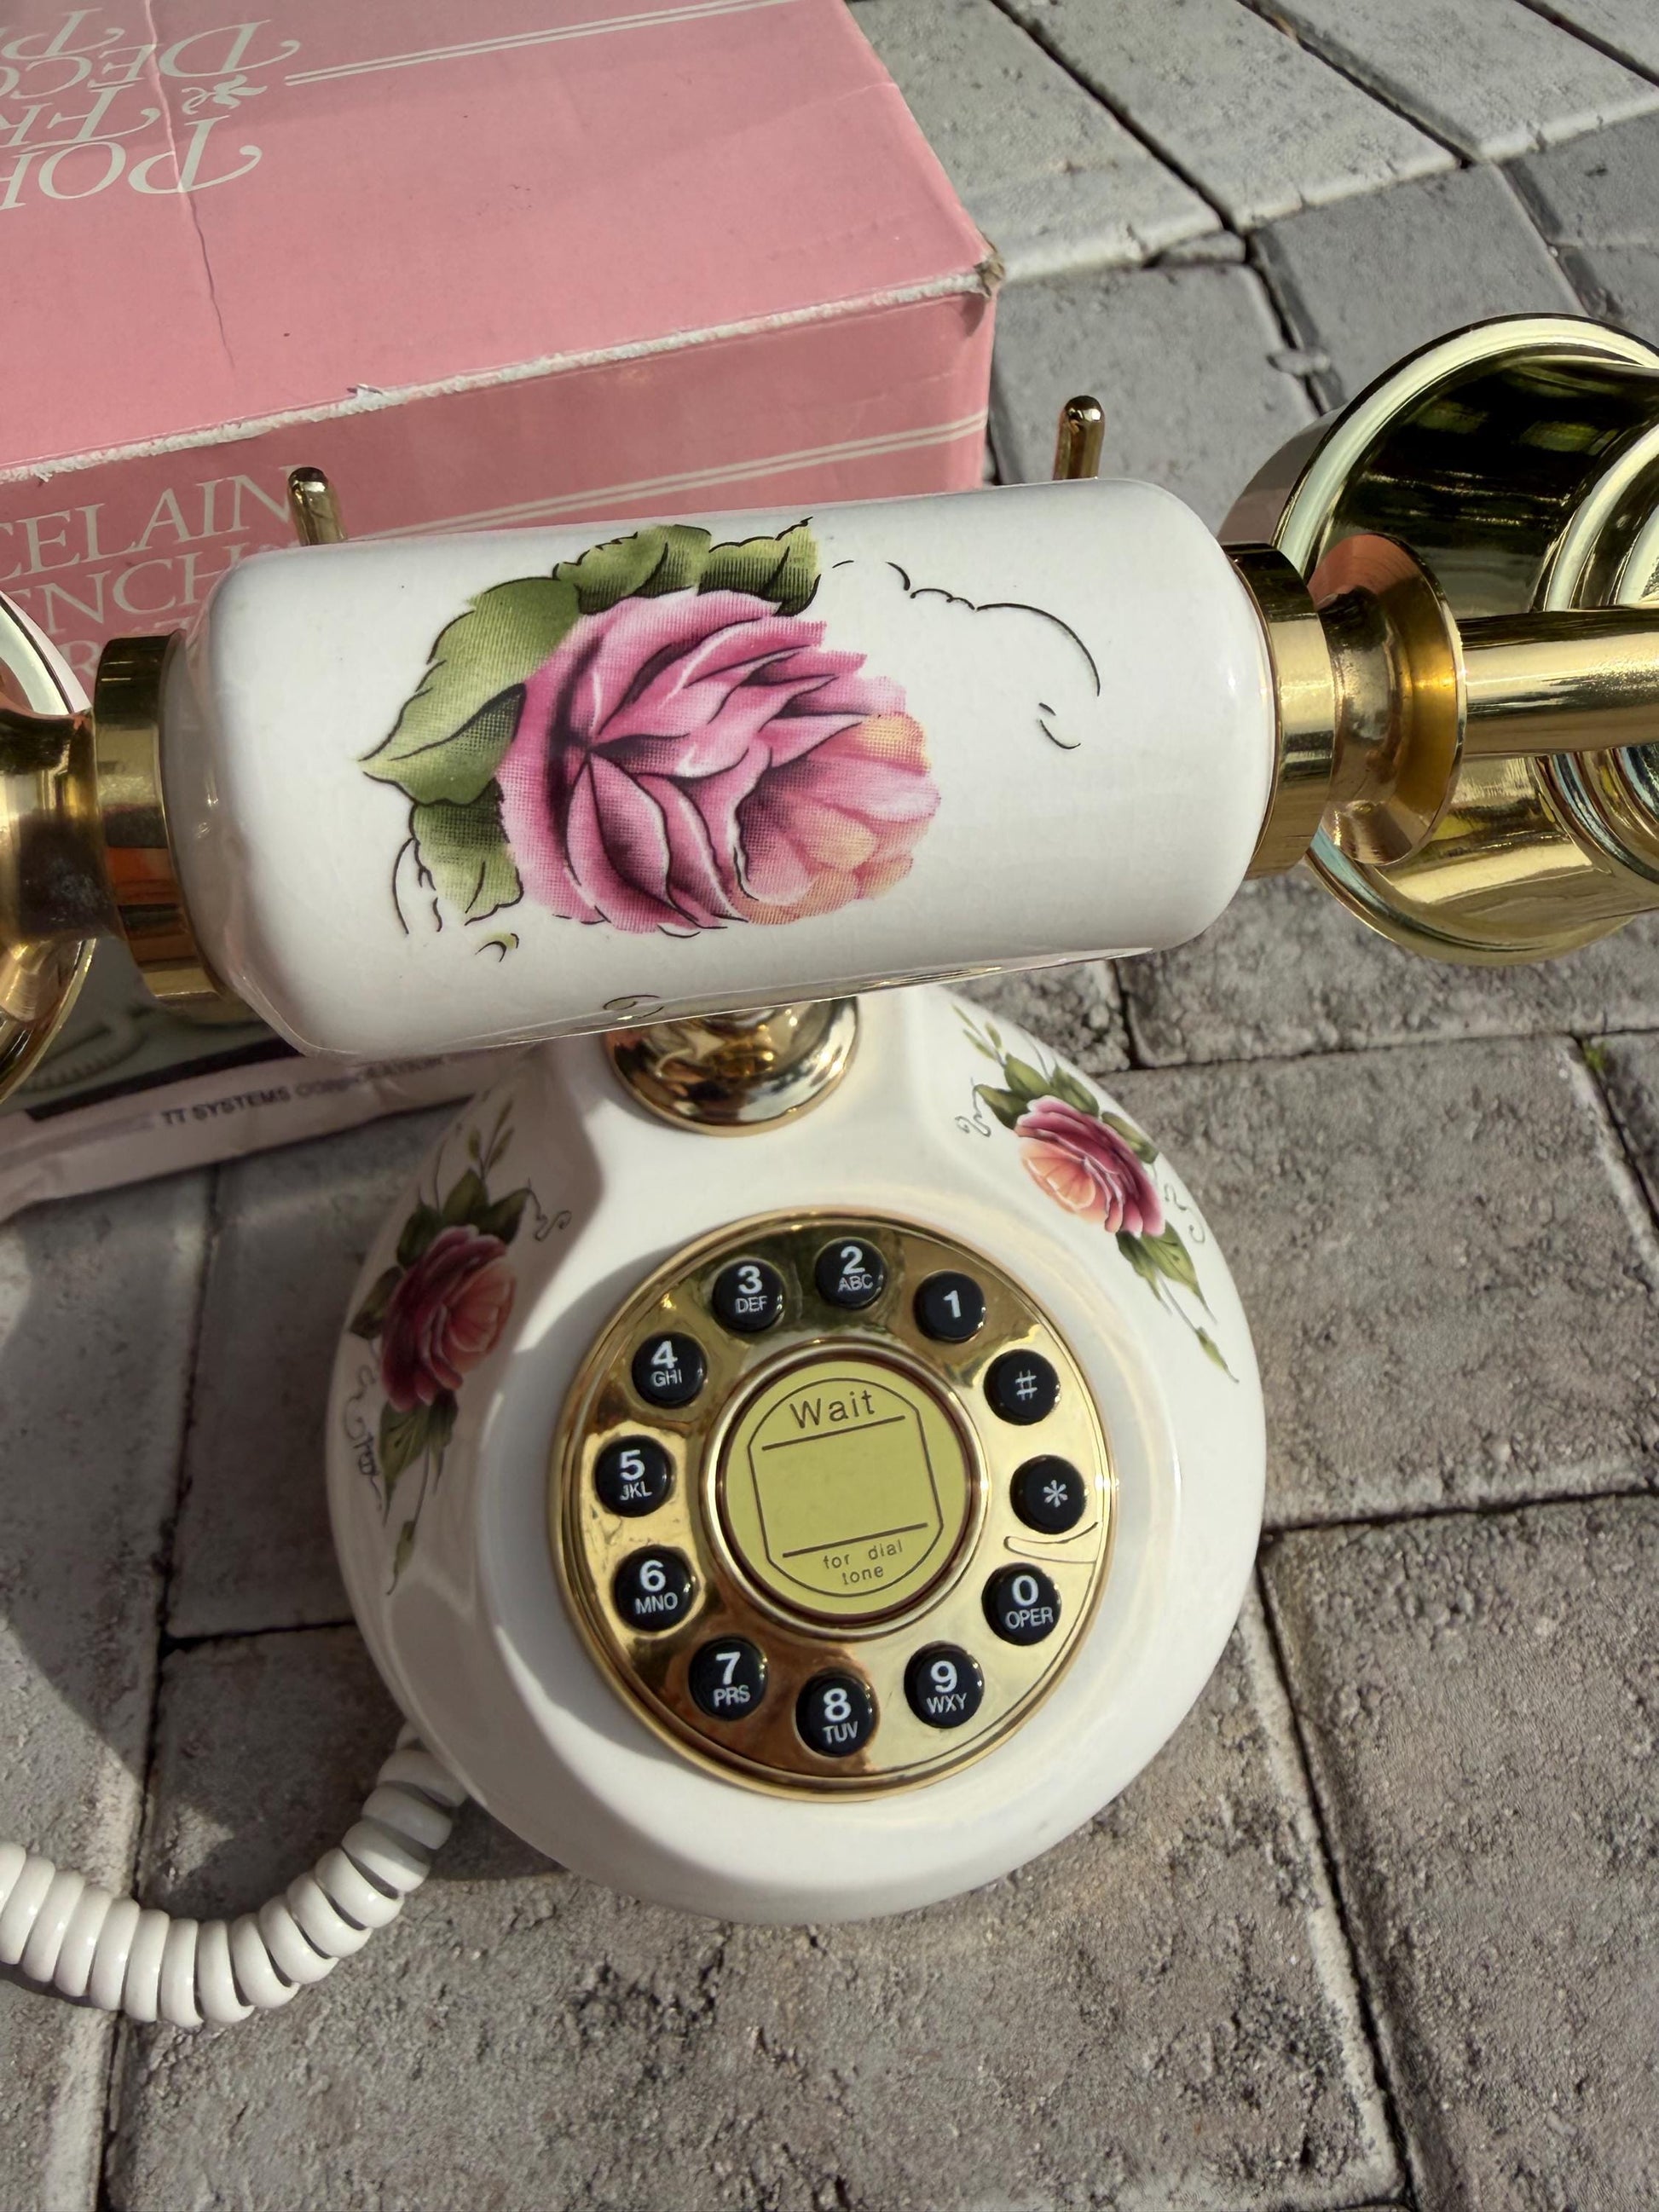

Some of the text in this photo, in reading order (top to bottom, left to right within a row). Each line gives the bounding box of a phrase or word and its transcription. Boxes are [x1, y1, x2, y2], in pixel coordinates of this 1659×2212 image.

[192, 1085, 292, 1121] SYSTEMS
[840, 1245, 865, 1275] 2
[736, 1265, 764, 1295] 3
[838, 1274, 874, 1293] ABC
[735, 1296, 767, 1314] DEF
[943, 1290, 962, 1319] 1
[650, 1340, 679, 1369] 4
[653, 1370, 683, 1389] GHI
[1014, 1369, 1038, 1401] #
[789, 1389, 876, 1429] Wait
[620, 1449, 645, 1481] 5
[620, 1481, 653, 1501] JKL
[823, 1539, 904, 1570] for dial
[639, 1559, 667, 1592] 6
[841, 1565, 885, 1586] tone
[634, 1591, 679, 1614] MNO
[1011, 1574, 1039, 1607] 0
[1005, 1607, 1054, 1630] OPER
[715, 1651, 742, 1685] 7
[930, 1660, 958, 1694] 9
[713, 1684, 752, 1707] PRS
[823, 1687, 852, 1723] 8
[926, 1692, 968, 1715] WXY
[822, 1721, 858, 1745] TUV
